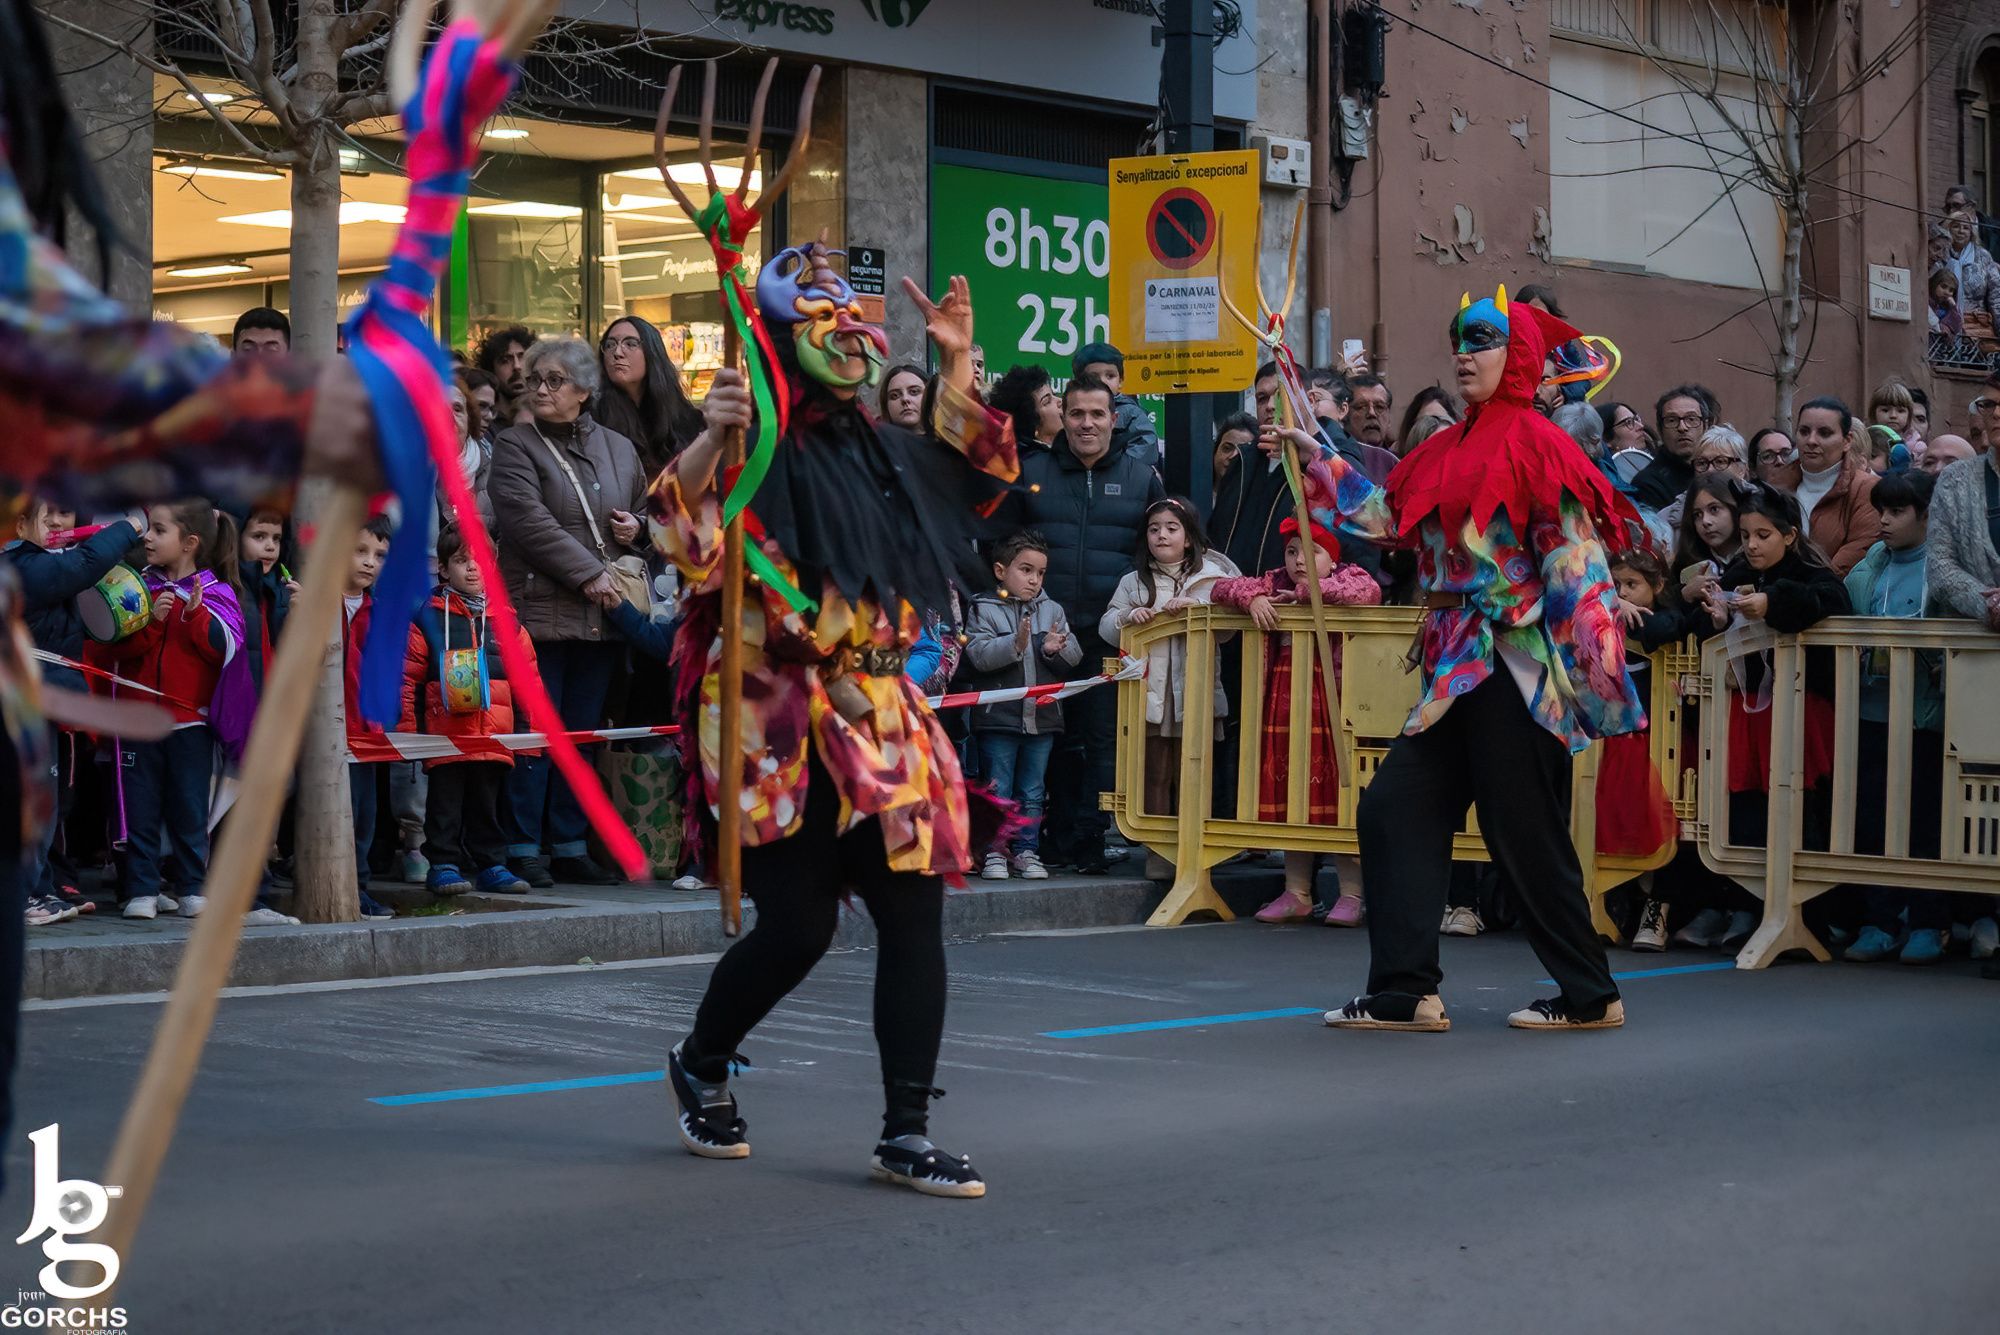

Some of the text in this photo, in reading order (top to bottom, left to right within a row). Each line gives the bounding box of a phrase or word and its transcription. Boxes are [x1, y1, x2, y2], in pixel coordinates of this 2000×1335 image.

[714, 0, 835, 35] express
[1116, 161, 1248, 184] Senyalització excepcional
[985, 207, 1109, 278] 8h30
[1159, 286, 1216, 298] CARNAVAL
[1017, 293, 1109, 356] 23h
[1149, 352, 1162, 361] per
[1164, 351, 1172, 359] la
